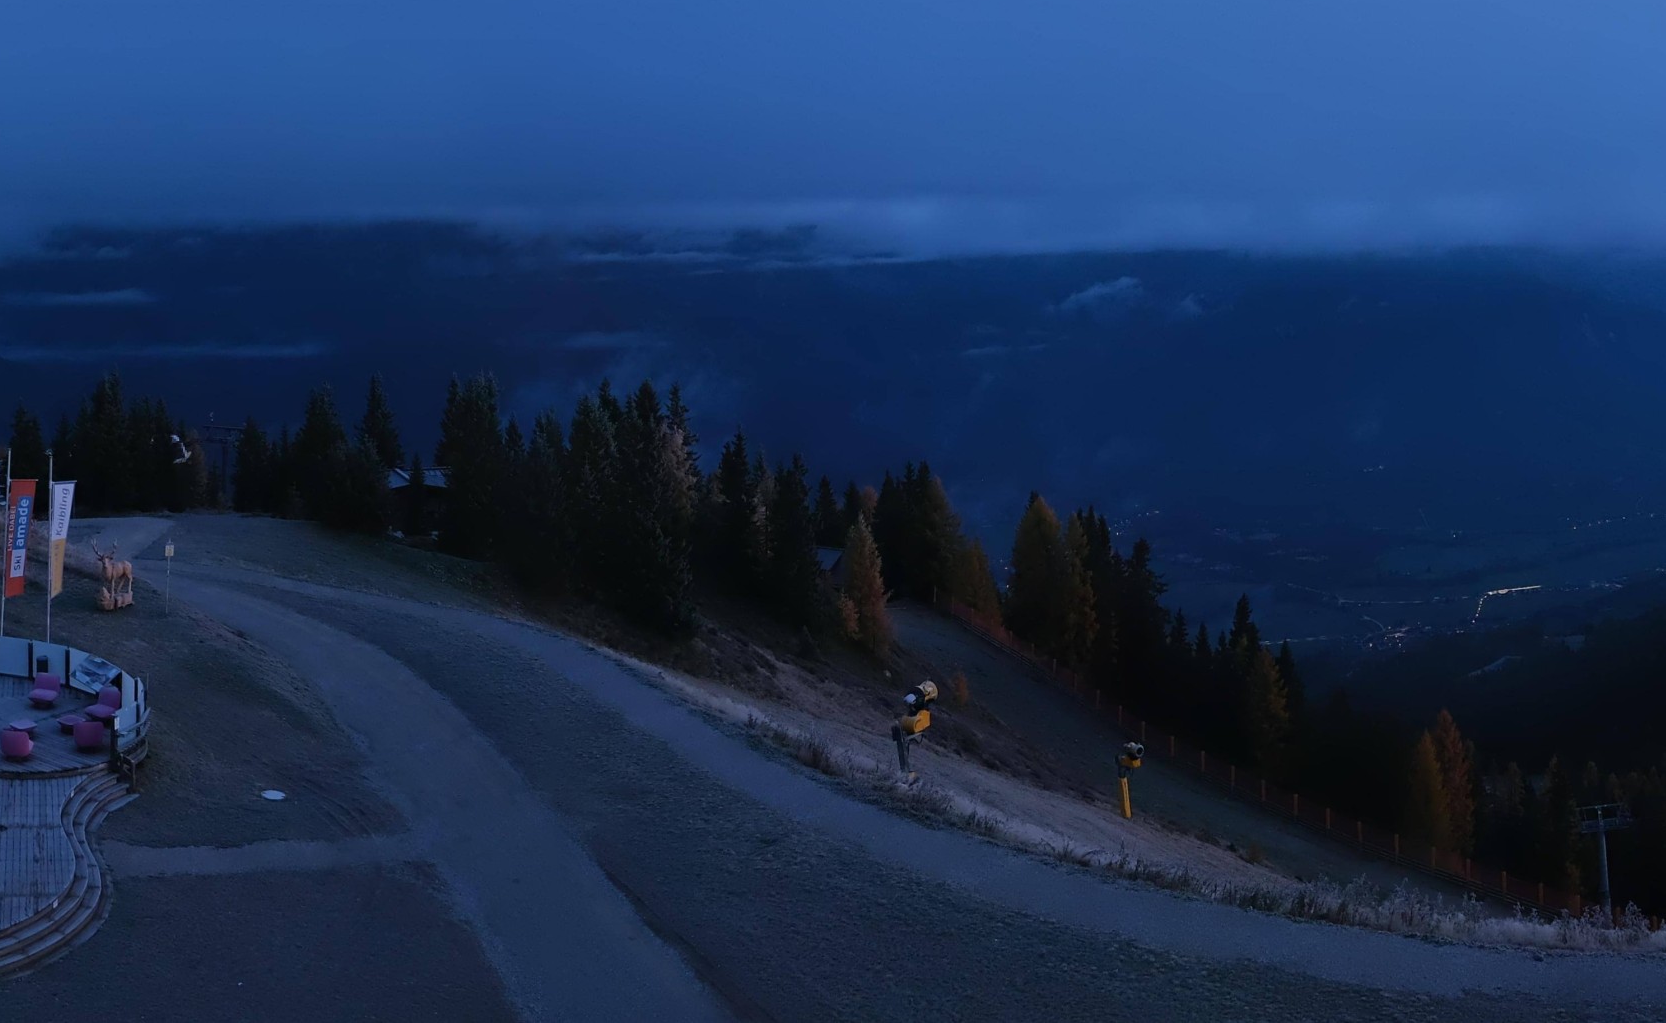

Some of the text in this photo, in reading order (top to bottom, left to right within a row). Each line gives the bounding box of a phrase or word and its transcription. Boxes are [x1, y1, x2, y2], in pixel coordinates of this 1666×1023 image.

[7, 505, 17, 552] LIVE DABEI
[55, 487, 70, 536] Kaibling
